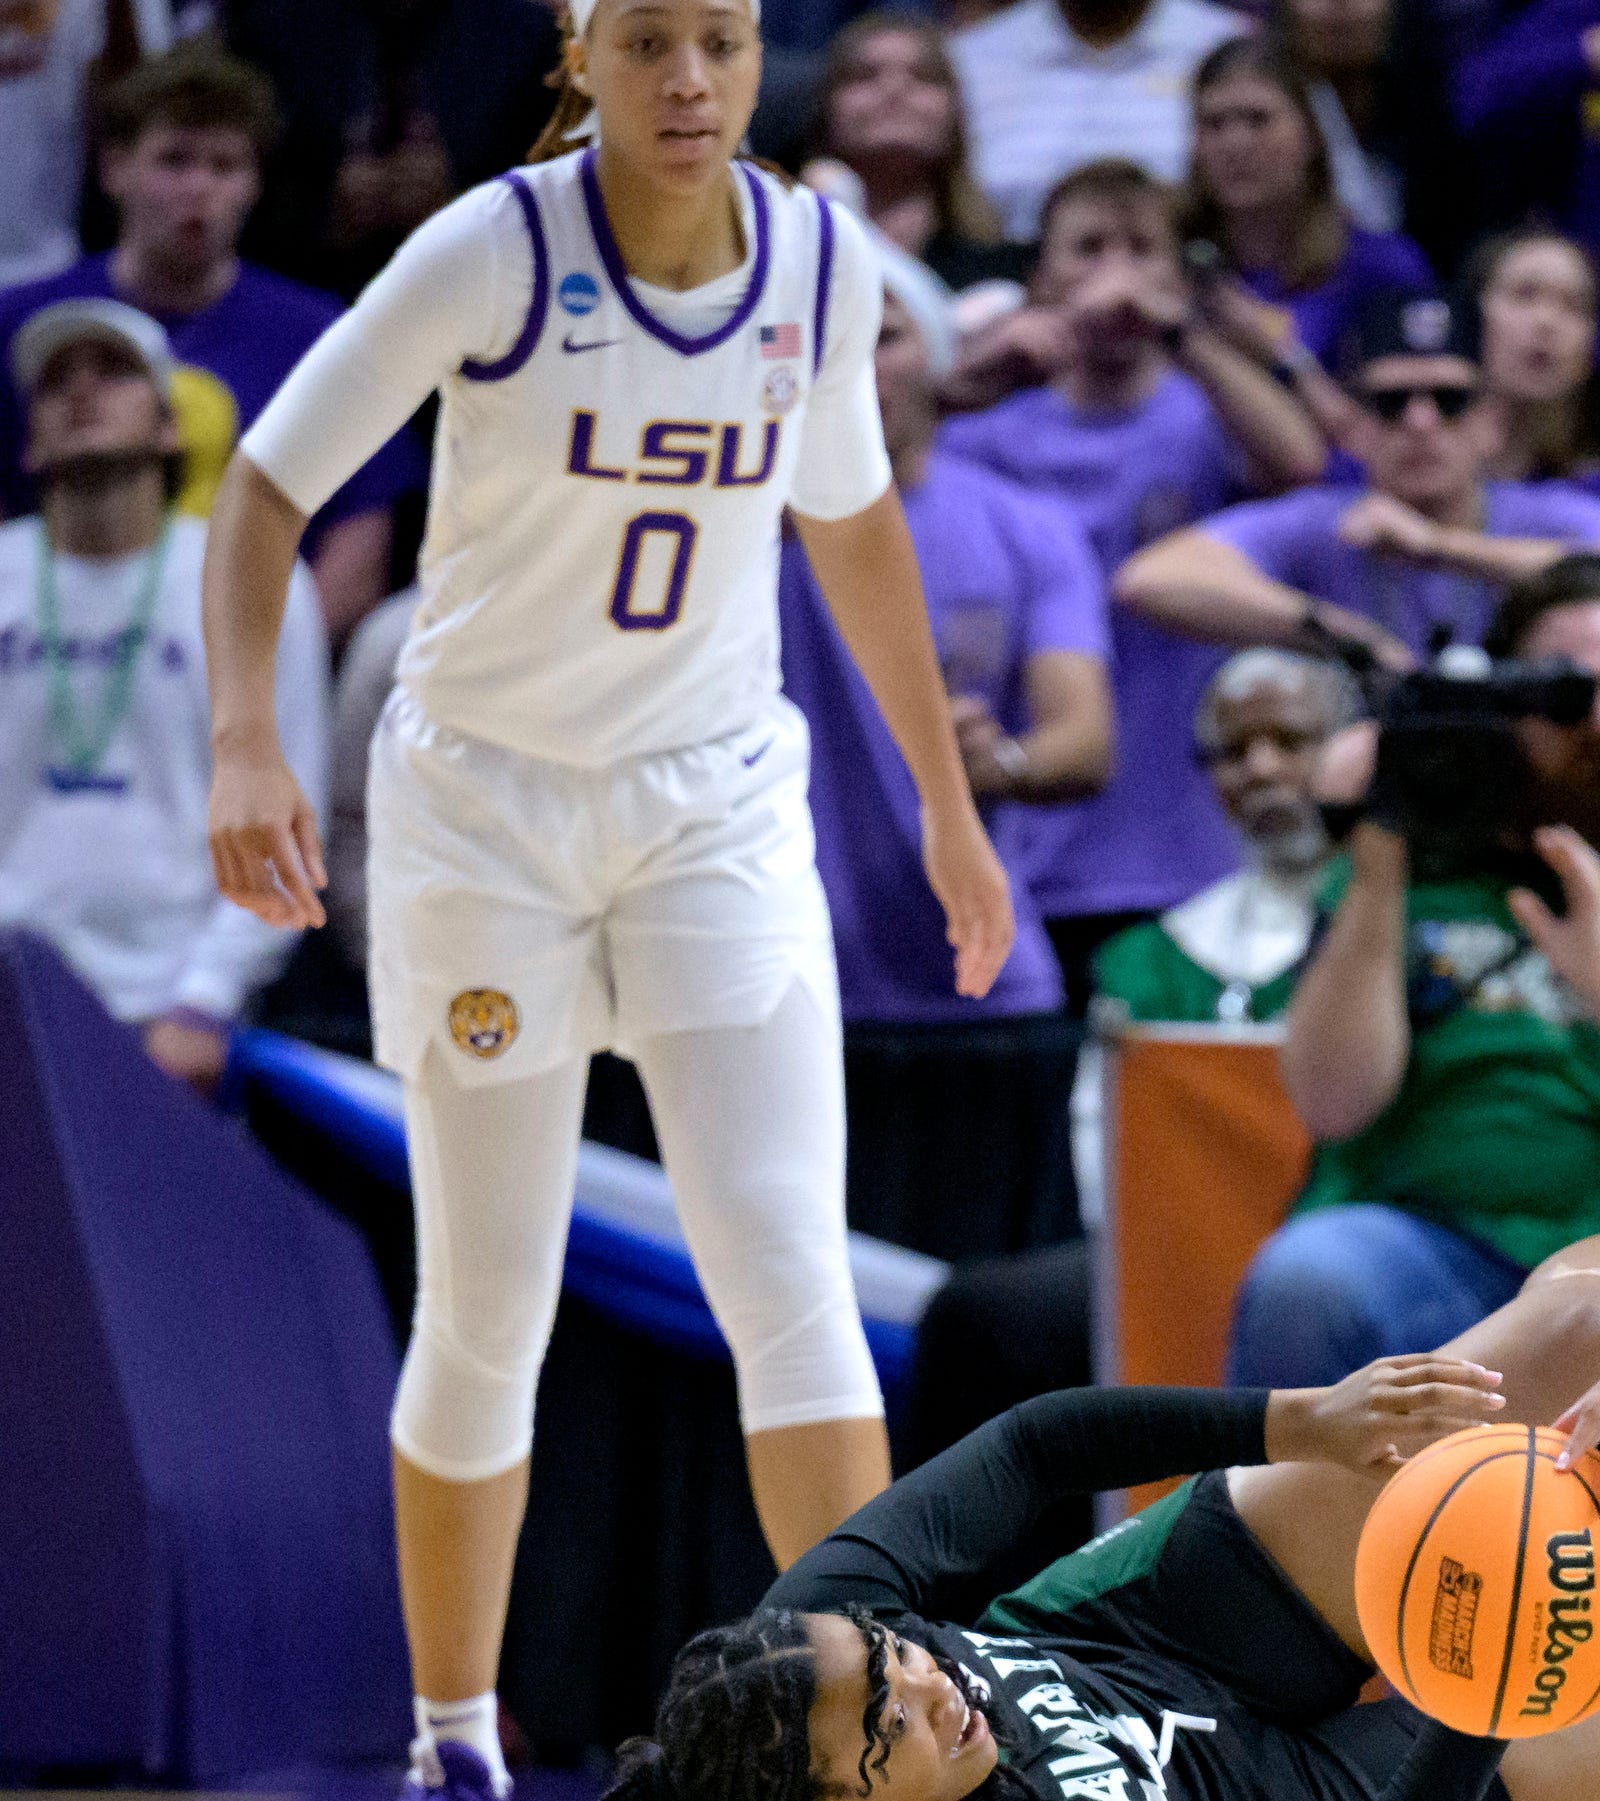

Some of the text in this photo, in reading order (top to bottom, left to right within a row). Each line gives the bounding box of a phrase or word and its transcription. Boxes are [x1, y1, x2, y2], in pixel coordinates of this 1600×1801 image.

[564, 407, 782, 489] LSU
[607, 508, 699, 632] 0
[1519, 1528, 1596, 1716] Wilson
